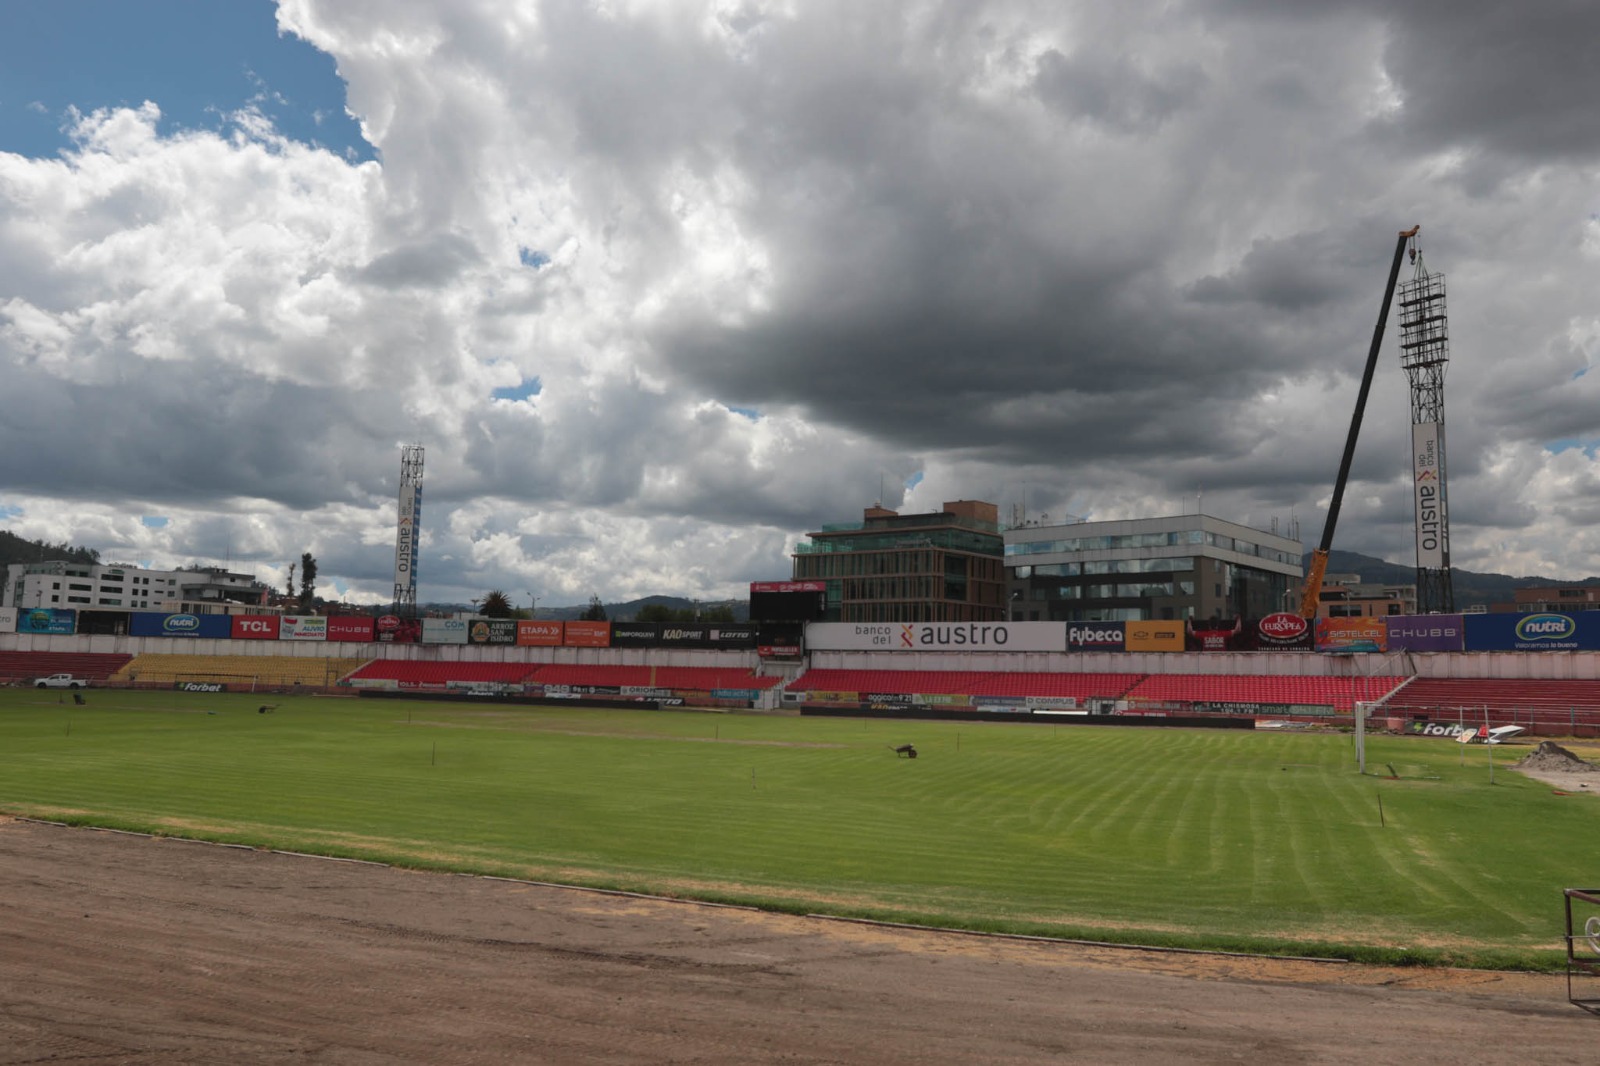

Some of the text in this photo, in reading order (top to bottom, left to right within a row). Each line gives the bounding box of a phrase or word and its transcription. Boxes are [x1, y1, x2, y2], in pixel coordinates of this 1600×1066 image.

[1426, 440, 1434, 466] banco
[1420, 485, 1440, 551] austro
[398, 527, 411, 573] austro
[239, 620, 271, 632] TCL
[520, 627, 548, 635] ETAPA
[855, 625, 891, 635] banco
[1264, 622, 1301, 632] EUROPEA
[662, 629, 703, 640] KAO SPORT
[920, 623, 1008, 645] austro
[1069, 626, 1123, 646] fybeca
[1329, 630, 1383, 638] SISTELCEL
[1389, 628, 1456, 637] CHUBB
[872, 635, 891, 645] del
[184, 682, 222, 692] forbet
[1423, 723, 1478, 736] forb
